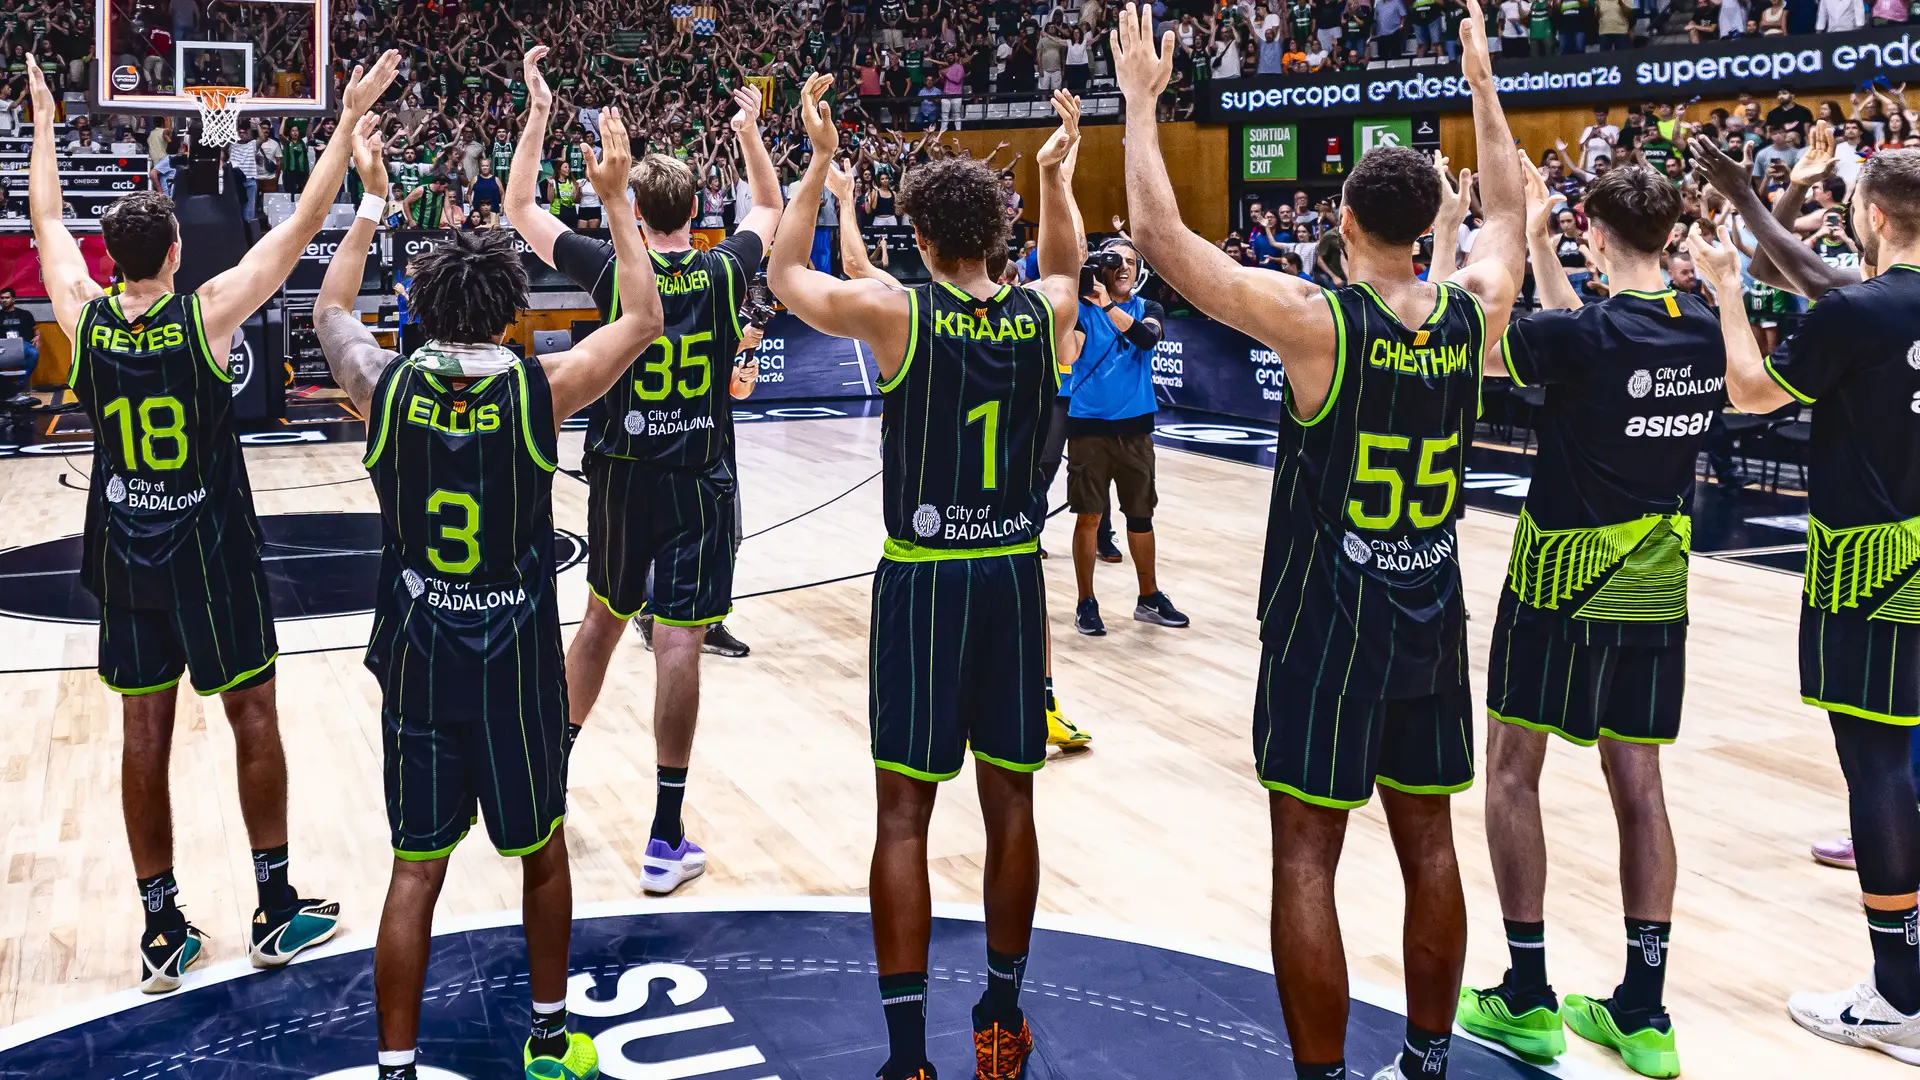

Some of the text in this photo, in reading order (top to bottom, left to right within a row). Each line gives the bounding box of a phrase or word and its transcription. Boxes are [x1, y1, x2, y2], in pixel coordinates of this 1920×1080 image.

[1636, 50, 1823, 87] supercopa
[1221, 83, 1361, 112] supercopa
[1250, 128, 1291, 143] SORTIDA
[1250, 144, 1285, 158] SALIDA
[1250, 160, 1272, 174] EXIT
[112, 180, 136, 190] acb
[935, 308, 1036, 342] KRAAG
[91, 323, 184, 353] REYES
[634, 331, 713, 401] 35
[1151, 353, 1183, 374] desa
[1250, 349, 1282, 365] super
[1255, 368, 1284, 387] end
[1656, 364, 1692, 381] City of
[1655, 377, 1724, 398] BADALON
[407, 395, 501, 434] ELLIS
[648, 408, 682, 423] City of
[104, 396, 188, 471] 18
[648, 416, 715, 436] BADALONA
[967, 401, 1000, 490] 1
[129, 478, 165, 494] City of
[1347, 431, 1460, 531] 55
[128, 487, 206, 511] BADALONA
[946, 505, 991, 522] City of
[426, 489, 482, 574] 3
[428, 588, 526, 611] BADALONA
